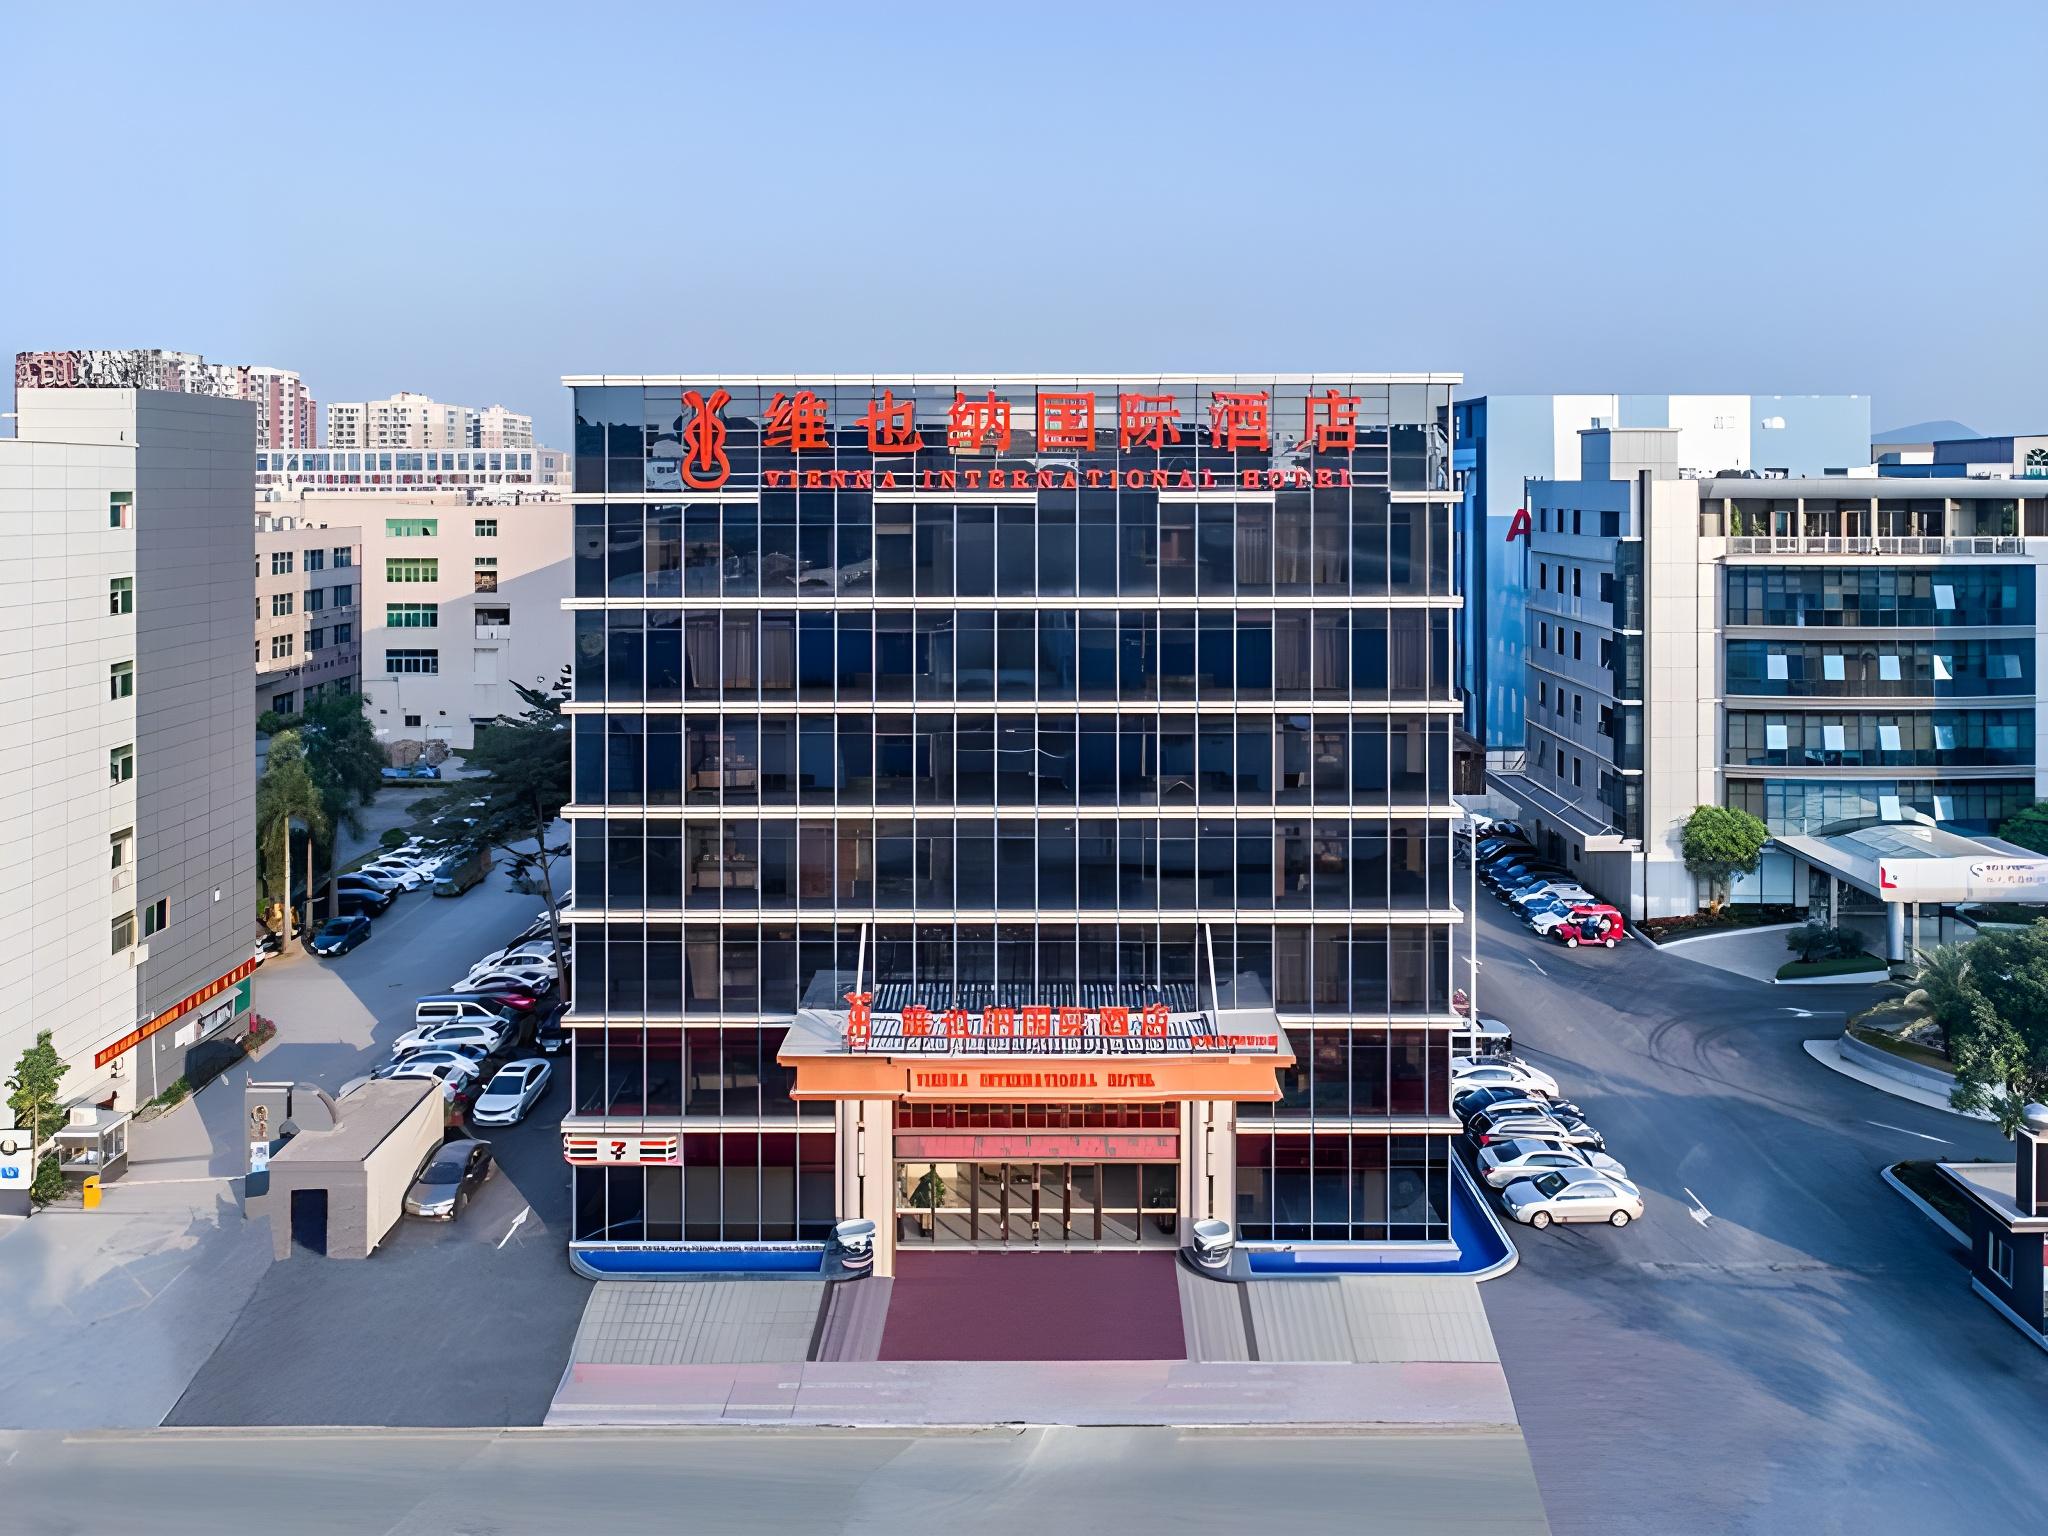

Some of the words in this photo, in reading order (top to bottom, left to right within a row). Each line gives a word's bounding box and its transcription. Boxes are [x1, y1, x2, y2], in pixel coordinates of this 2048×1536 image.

[764, 389, 1362, 453] 维也纳国际酒店
[764, 469, 896, 488] VIENNA
